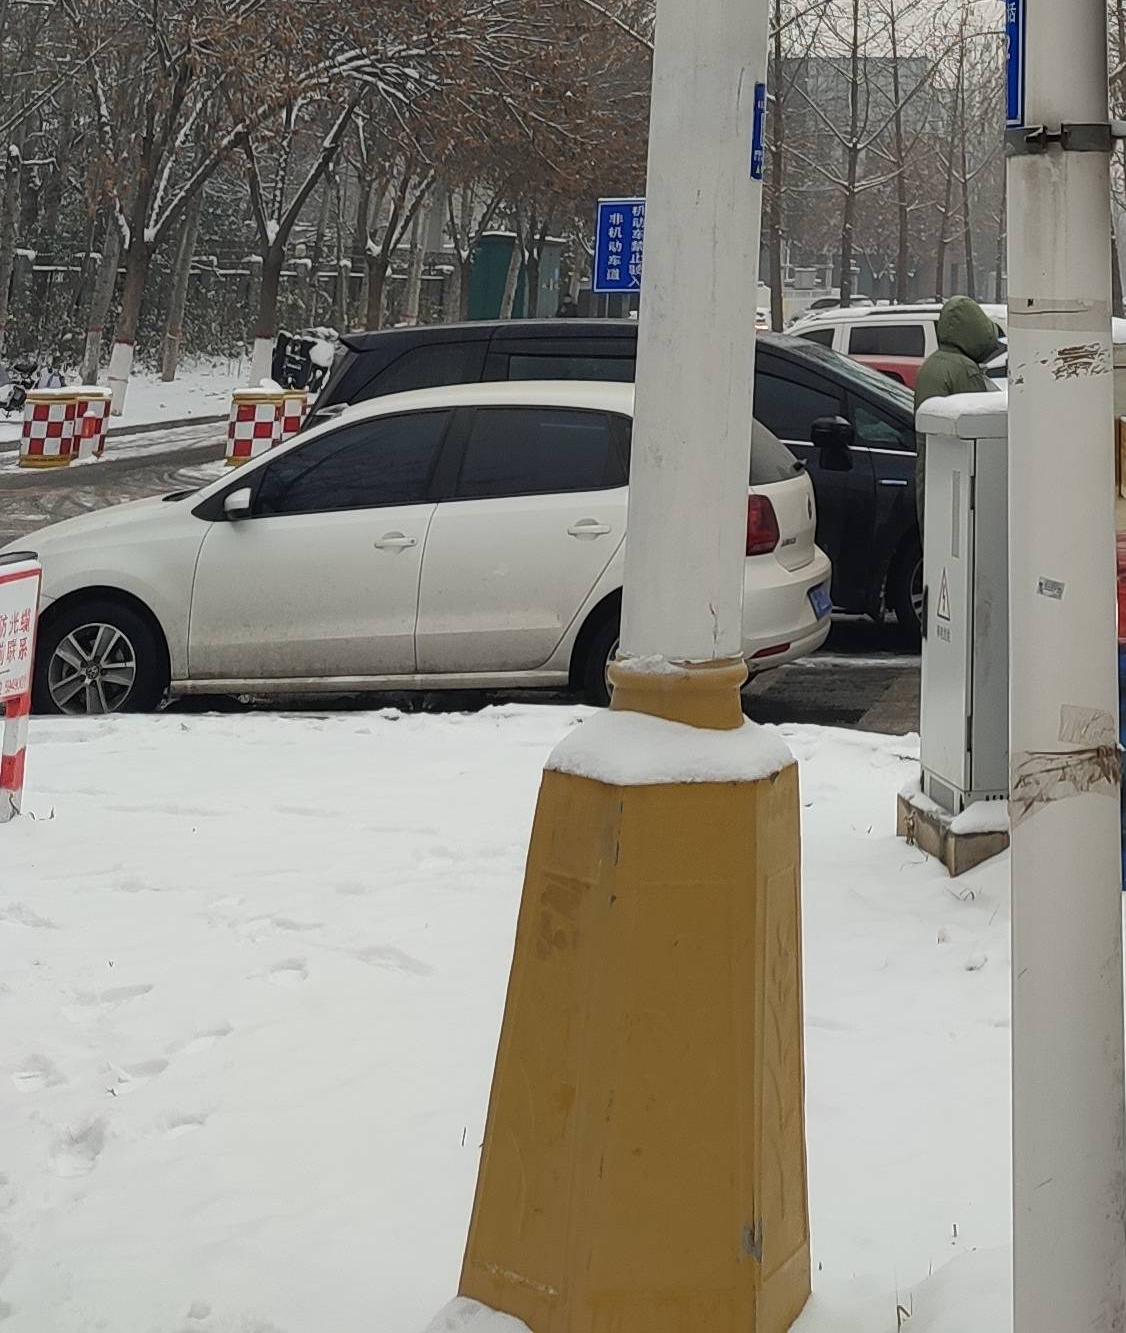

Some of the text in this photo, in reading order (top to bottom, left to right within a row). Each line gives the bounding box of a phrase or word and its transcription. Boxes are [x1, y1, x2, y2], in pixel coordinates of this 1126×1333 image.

[606, 212, 624, 281] 非机动车道
